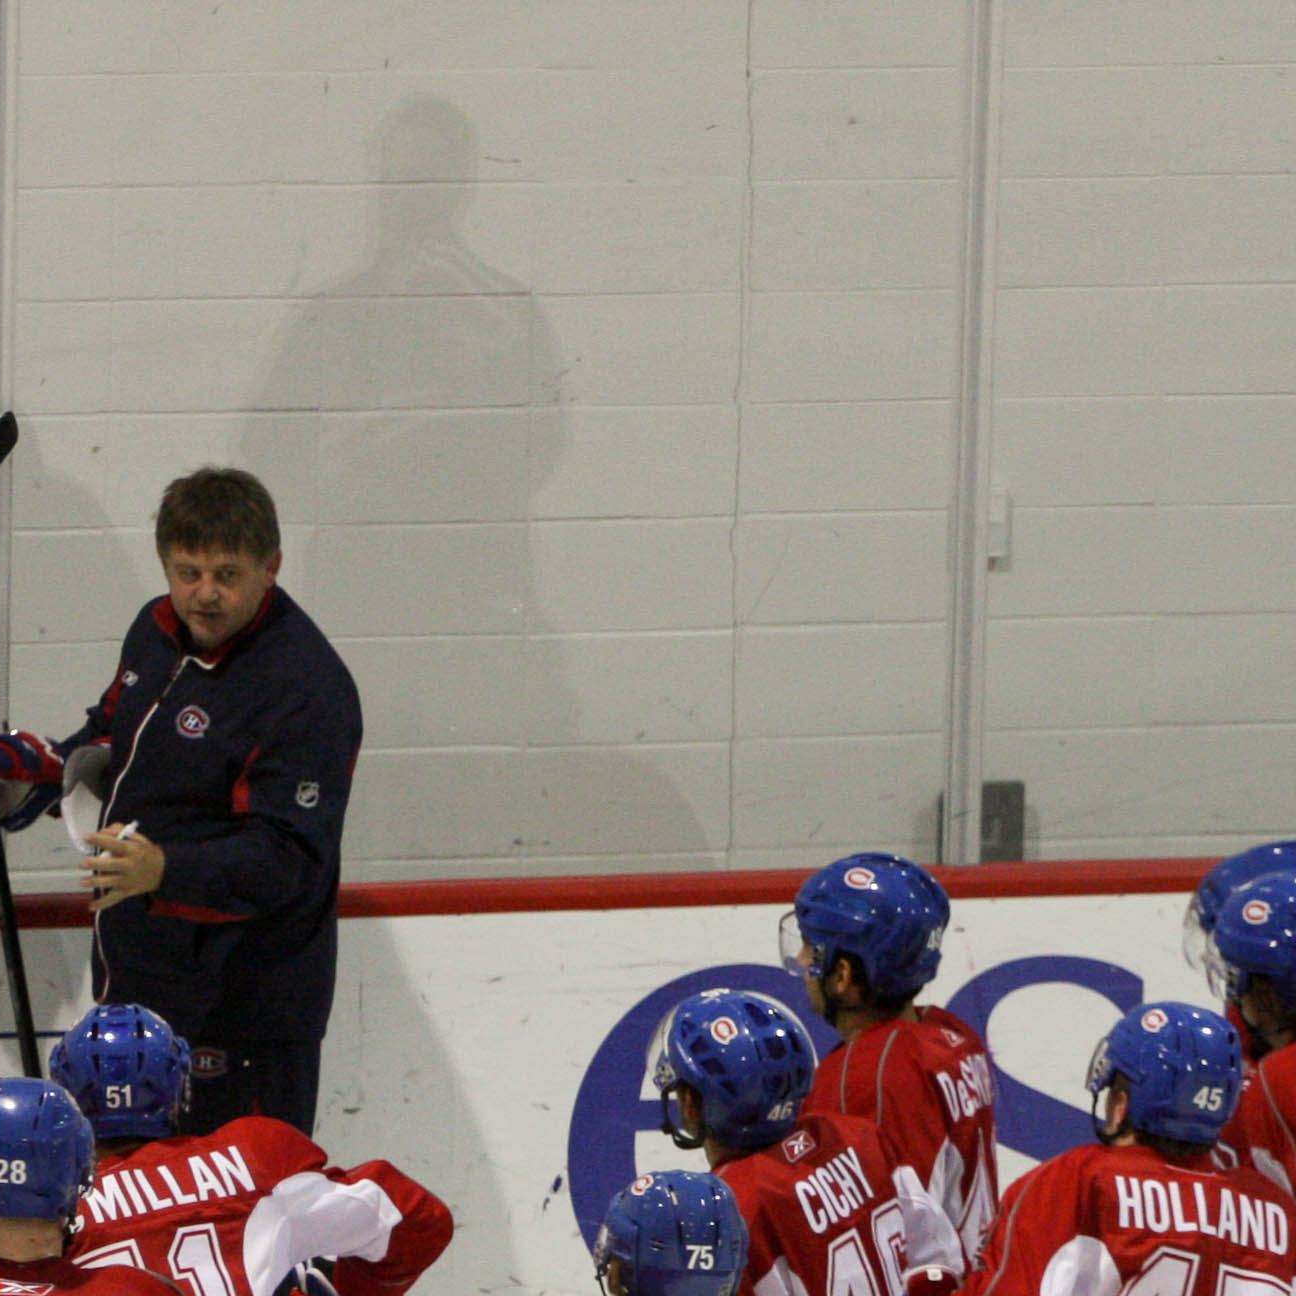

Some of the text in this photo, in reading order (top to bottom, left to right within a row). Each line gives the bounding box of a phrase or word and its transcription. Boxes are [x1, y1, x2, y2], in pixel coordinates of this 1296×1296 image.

[106, 1083, 133, 1109] 51
[1192, 1085, 1224, 1112] 45
[767, 1101, 795, 1121] 46
[794, 1146, 875, 1235] CICHY
[1114, 1174, 1290, 1257] HOLLAND
[685, 1244, 715, 1270] 75
